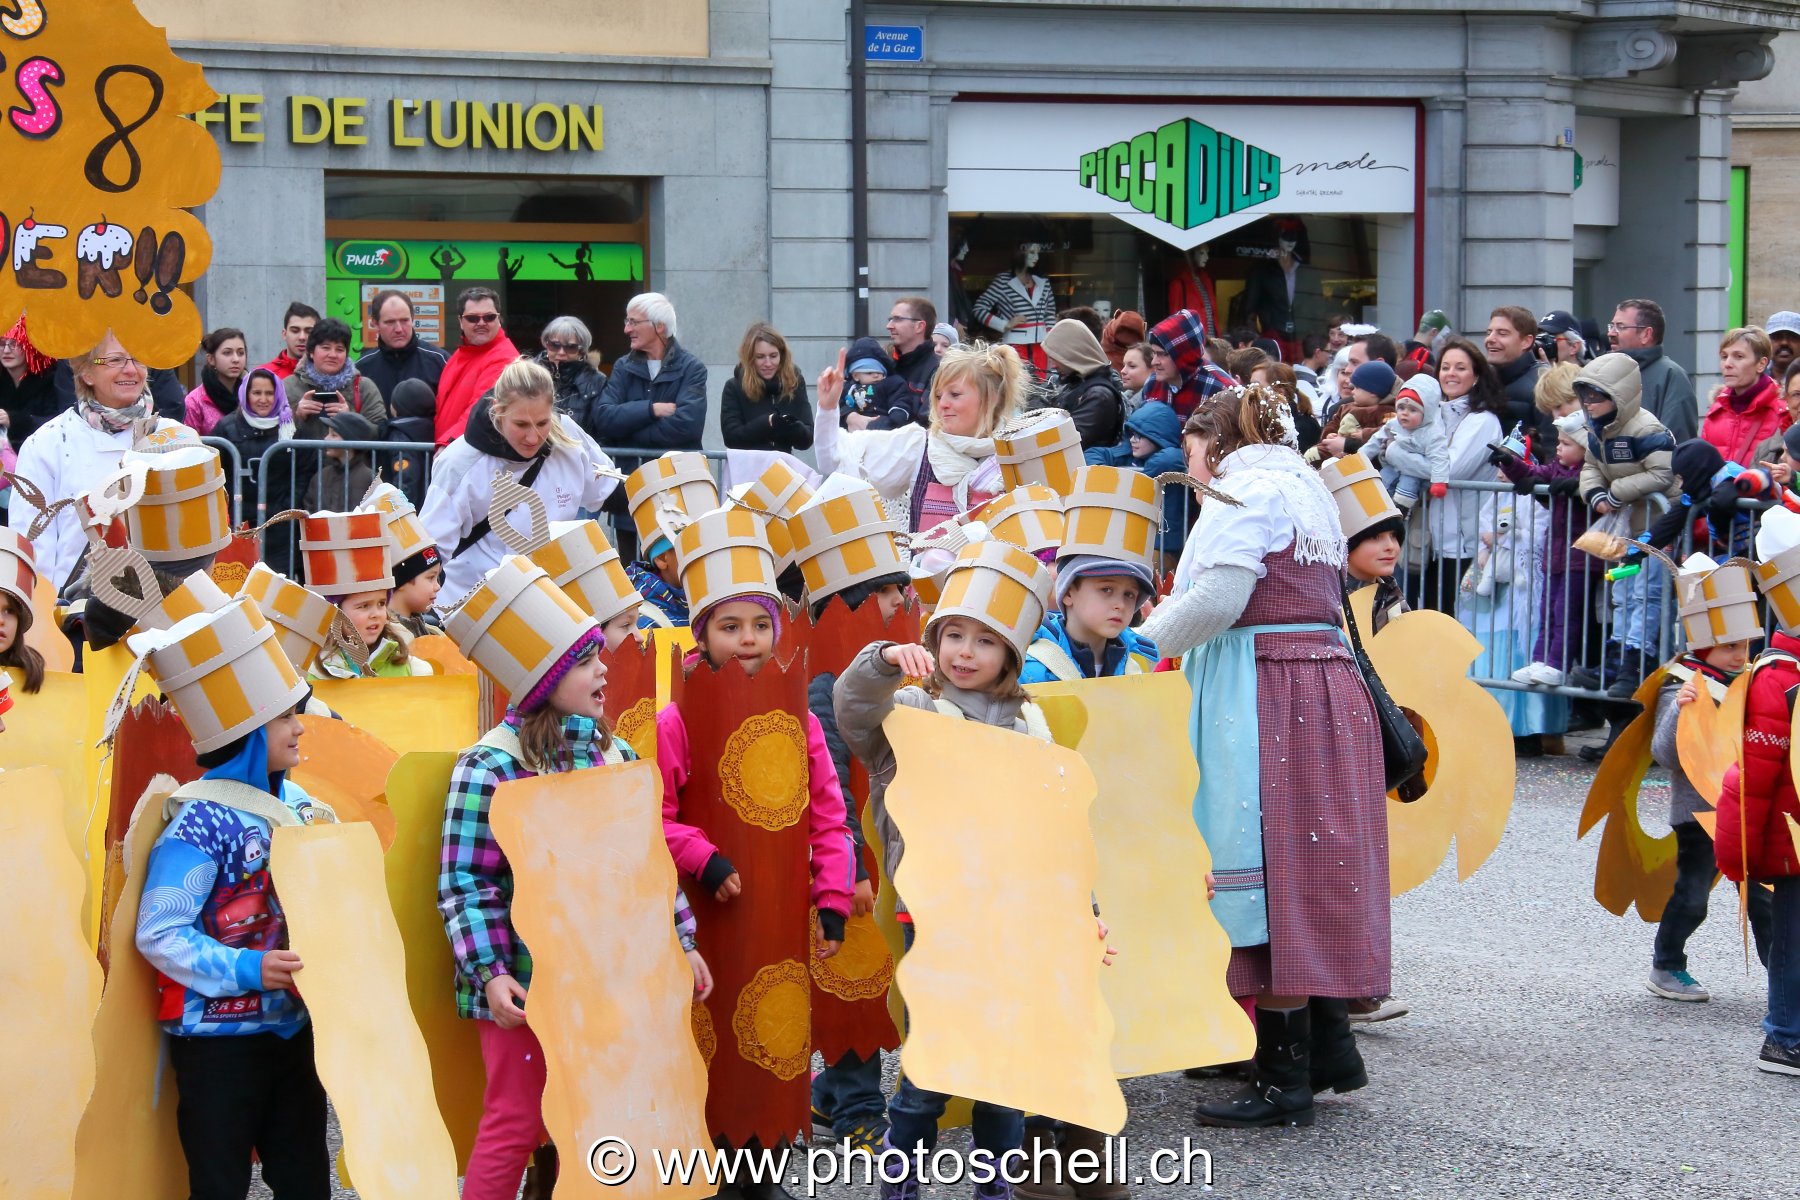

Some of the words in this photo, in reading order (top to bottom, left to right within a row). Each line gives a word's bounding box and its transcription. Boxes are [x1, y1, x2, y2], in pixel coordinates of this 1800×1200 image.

[868, 42, 880, 53] de
[881, 42, 891, 53] la
[893, 43, 917, 53] Gare
[875, 31, 909, 41] Avenue
[83, 64, 164, 193] 8
[287, 95, 368, 146] DE
[392, 97, 604, 151] L'UNION
[1281, 152, 1409, 176] mode
[0, 206, 186, 316] ER!!
[346, 254, 376, 266] PMU
